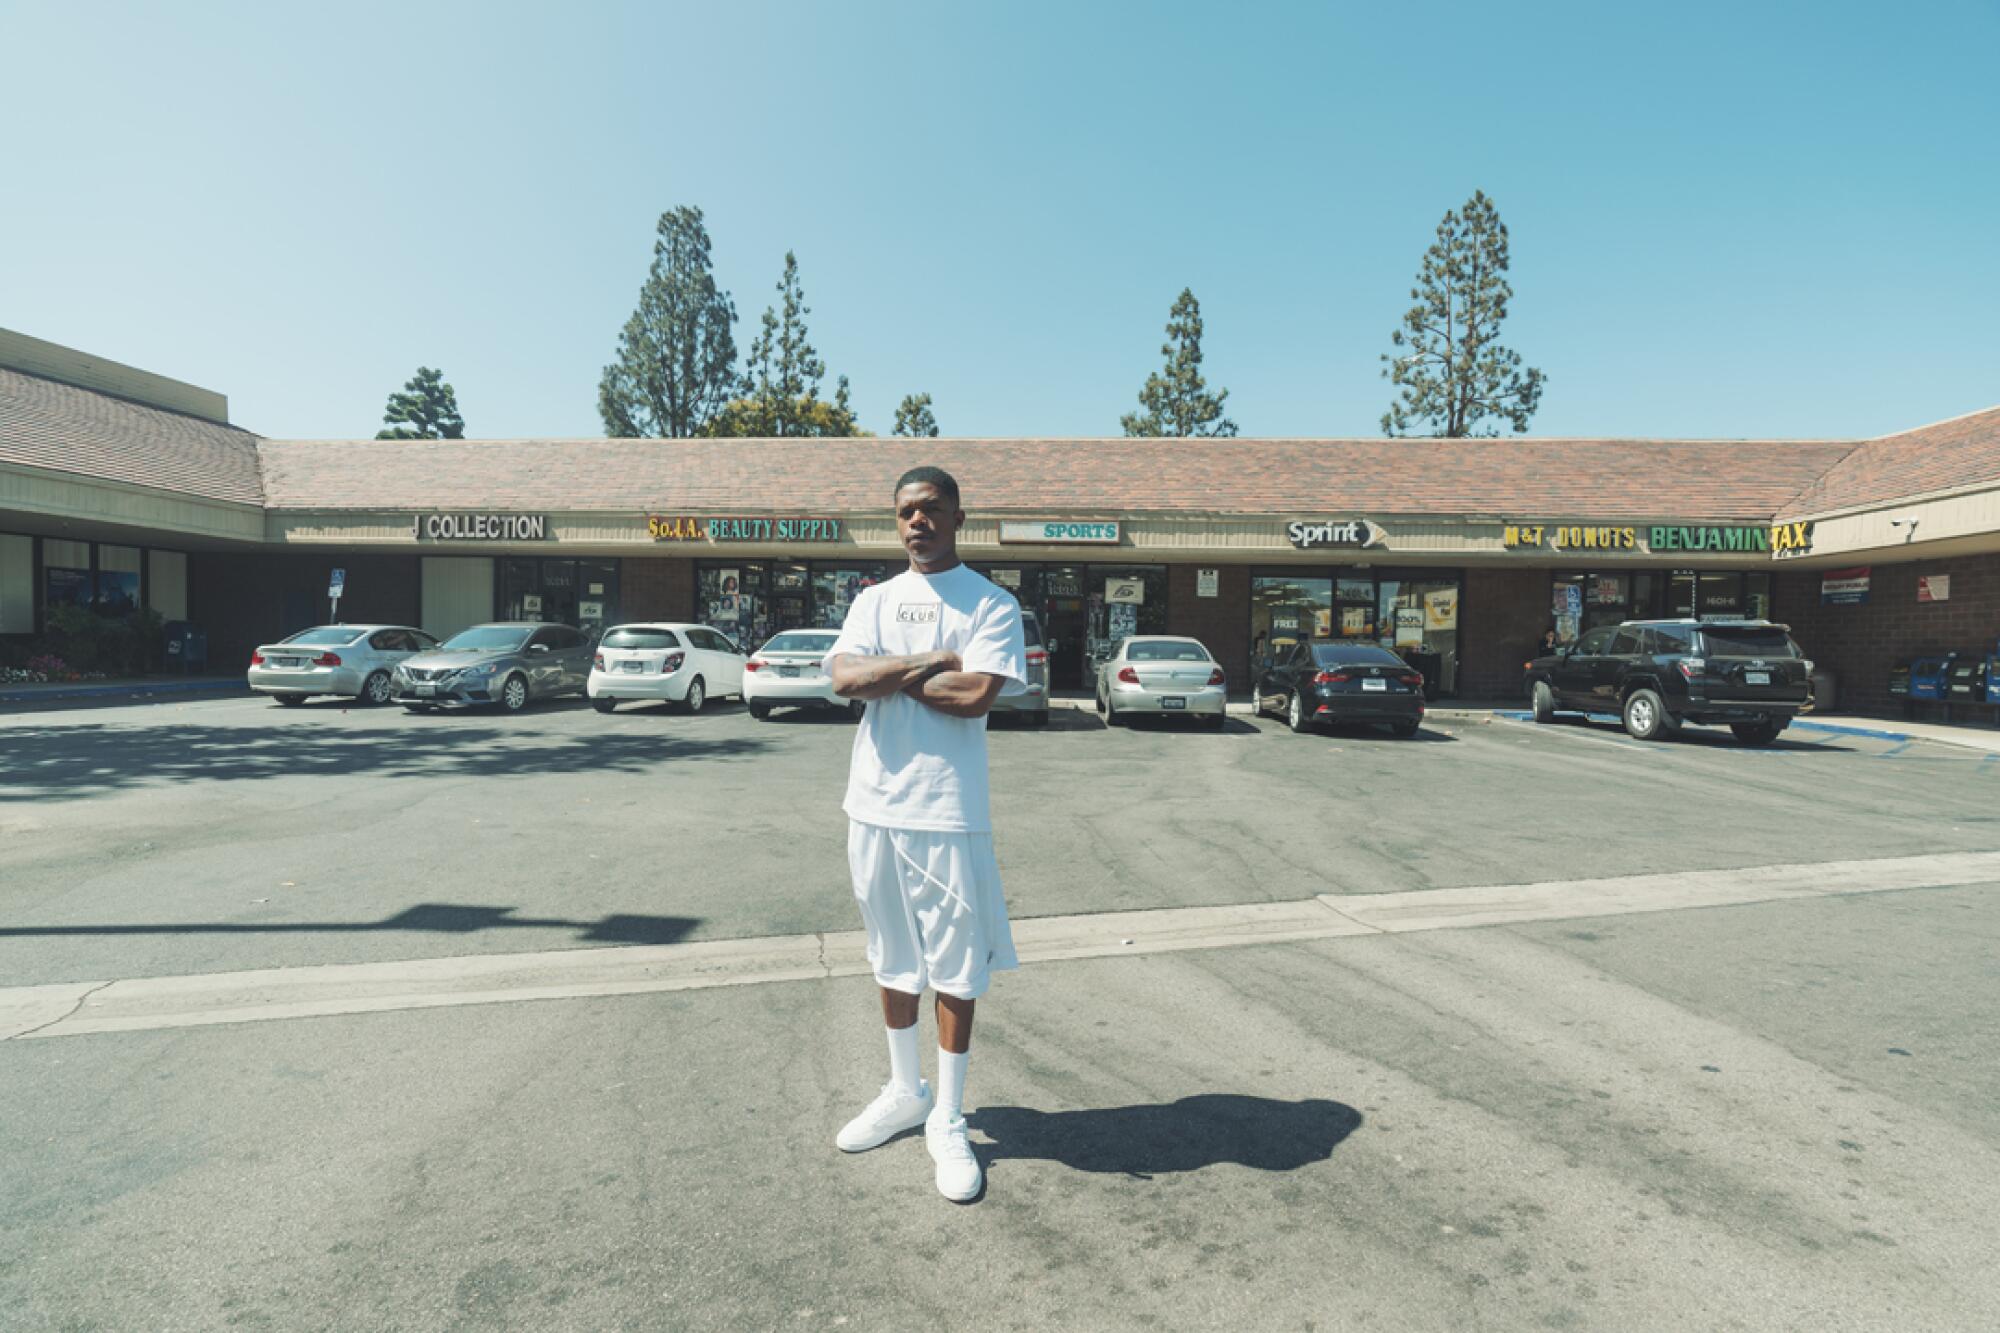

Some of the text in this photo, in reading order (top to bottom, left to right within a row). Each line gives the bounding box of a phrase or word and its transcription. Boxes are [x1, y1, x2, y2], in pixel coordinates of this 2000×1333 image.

[428, 515, 544, 539] COLLECTION
[709, 519, 772, 539] BEAUTY
[777, 519, 840, 539] SUPPLY
[1044, 523, 1117, 538] SPORTS
[1289, 521, 1359, 547] Sprint
[1504, 526, 1635, 548] M&T DONUTS
[1651, 521, 1807, 552] BENJAMIN TAX
[901, 610, 935, 621] CLUB
